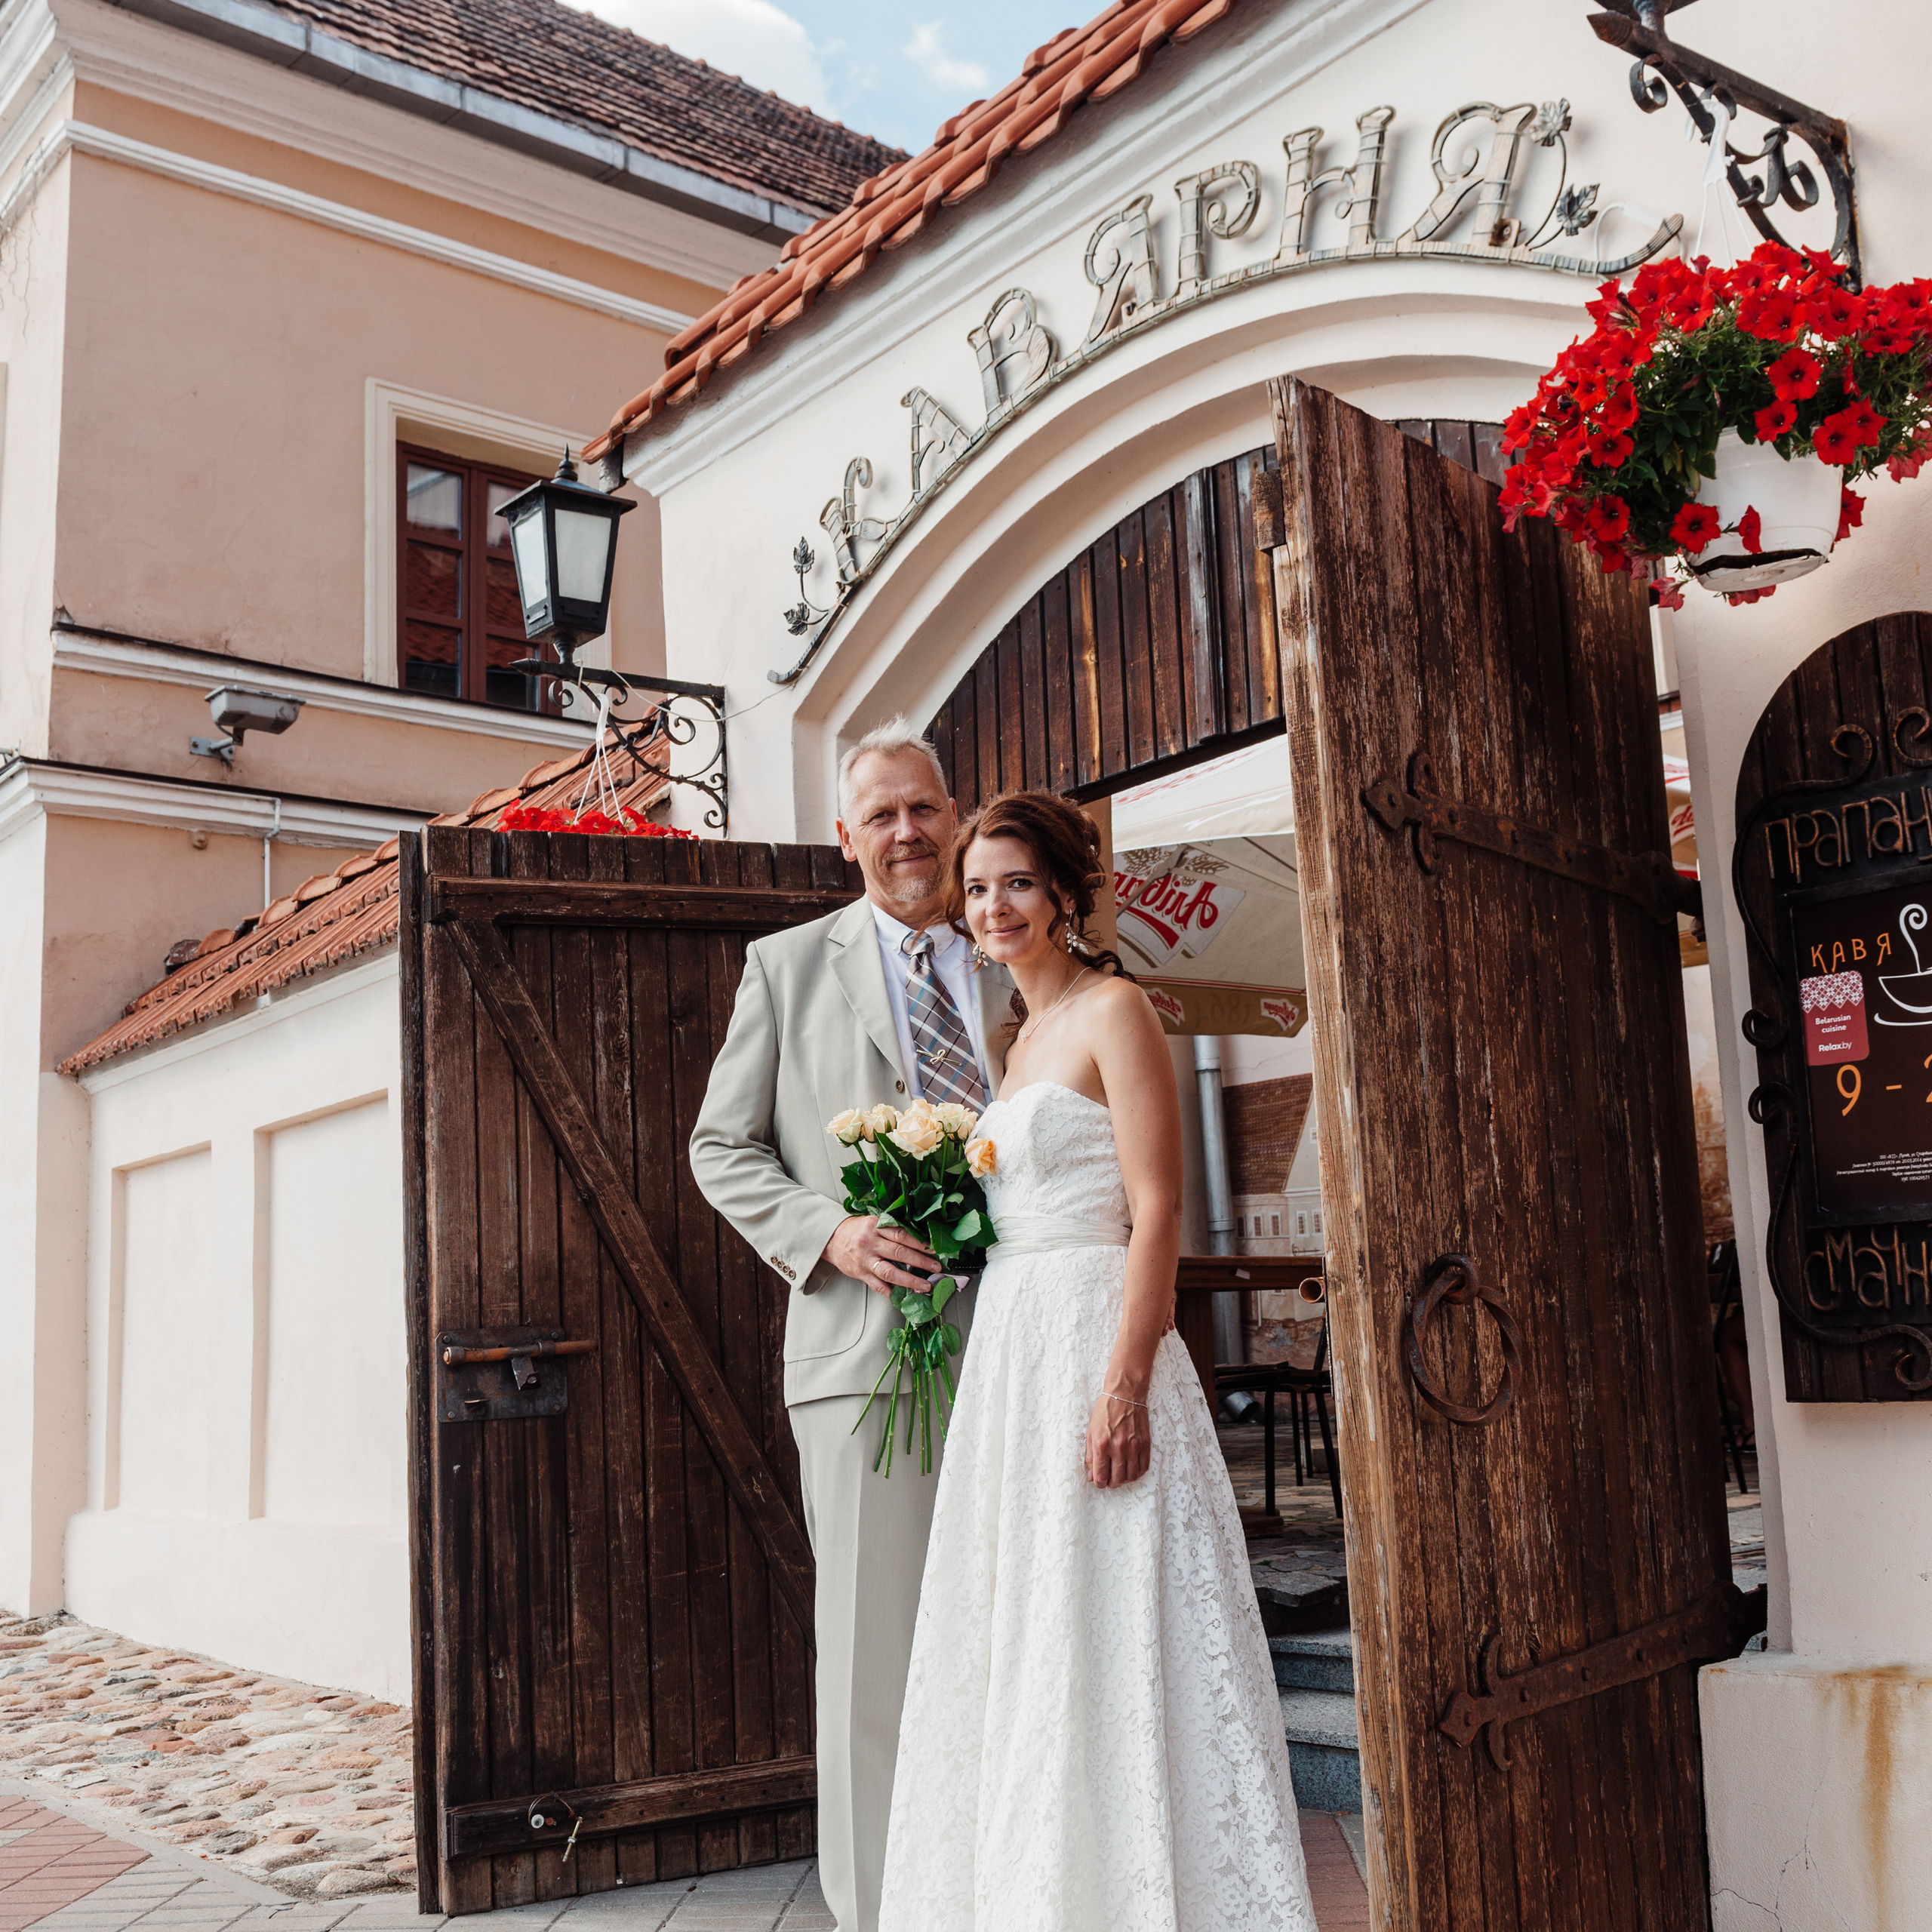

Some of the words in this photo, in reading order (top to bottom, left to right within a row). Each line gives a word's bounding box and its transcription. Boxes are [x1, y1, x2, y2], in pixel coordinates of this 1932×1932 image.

[820, 101, 1537, 584] КАВЯРНЯ
[1811, 933, 1892, 974] КАВЯ
[1815, 1014, 1851, 1025] Belarusian
[1821, 1025, 1847, 1033] cuisine
[1819, 1041, 1852, 1052] Relax.by
[1837, 1064, 1861, 1116] 9
[1804, 1223, 1932, 1312] смачн
